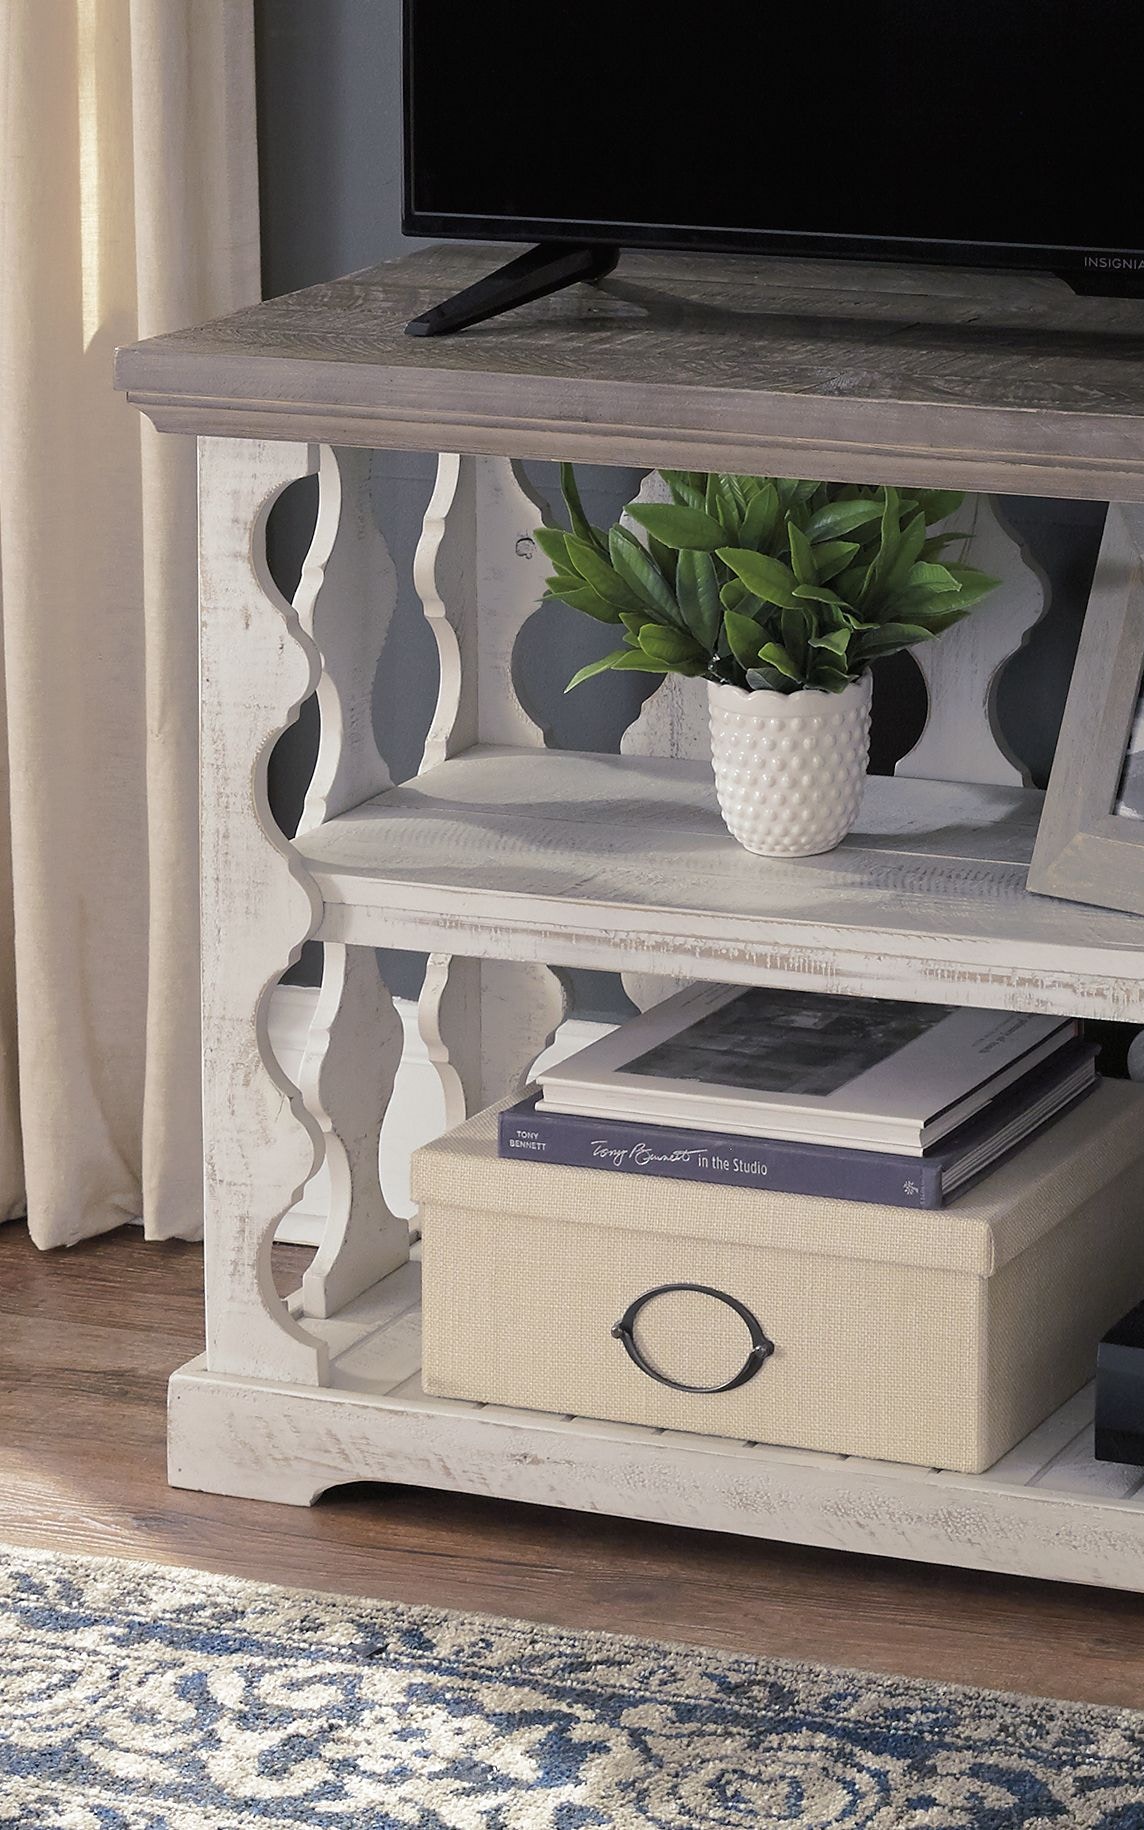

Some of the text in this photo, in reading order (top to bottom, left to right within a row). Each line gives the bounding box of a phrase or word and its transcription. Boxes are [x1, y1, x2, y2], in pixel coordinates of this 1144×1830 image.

[516, 1130, 539, 1140] TONY
[509, 1139, 546, 1151] BENNETT
[591, 1140, 628, 1166] Tony
[698, 1154, 709, 1169] in
[712, 1156, 730, 1171] the
[734, 1158, 768, 1176] Studio
